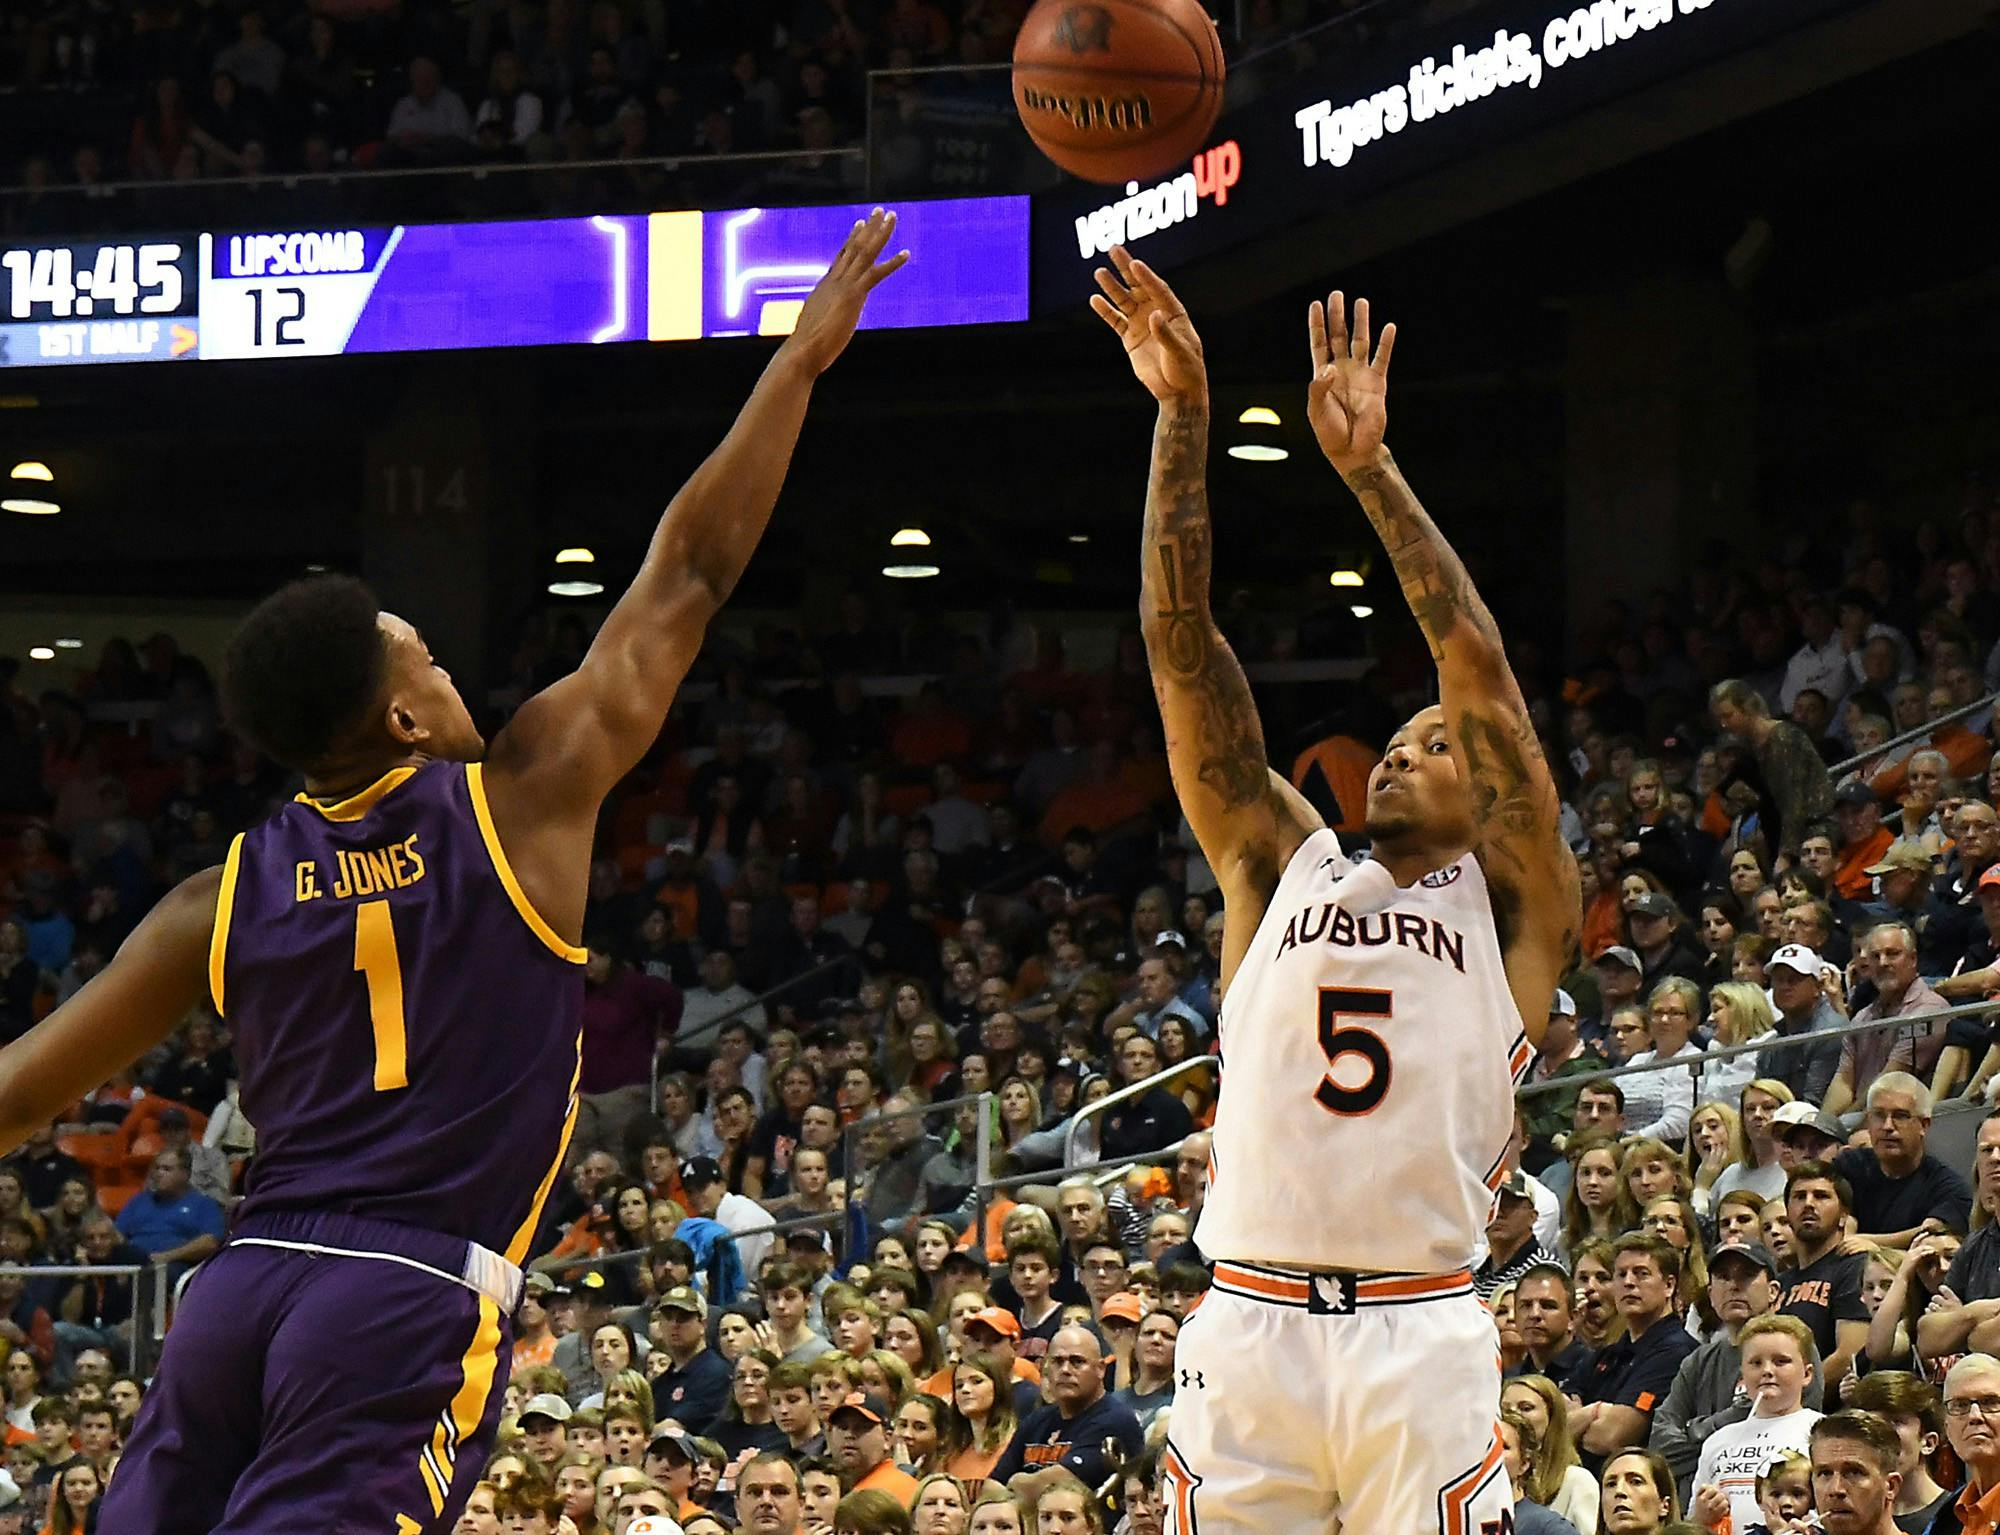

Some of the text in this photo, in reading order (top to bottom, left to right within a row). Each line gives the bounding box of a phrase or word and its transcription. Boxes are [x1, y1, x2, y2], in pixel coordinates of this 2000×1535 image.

[1295, 0, 1716, 168] Tigers tickets, concer
[2, 244, 182, 318] 14:45
[230, 231, 364, 276] LIPSCOMB
[39, 323, 88, 357] 1ST
[90, 320, 160, 355] HALF
[245, 287, 305, 346] 12
[383, 466, 468, 517] 114
[296, 833, 426, 902] G. JONES
[1275, 903, 1466, 974] AUBURN
[354, 899, 408, 1092] 1
[1313, 985, 1393, 1117] 5
